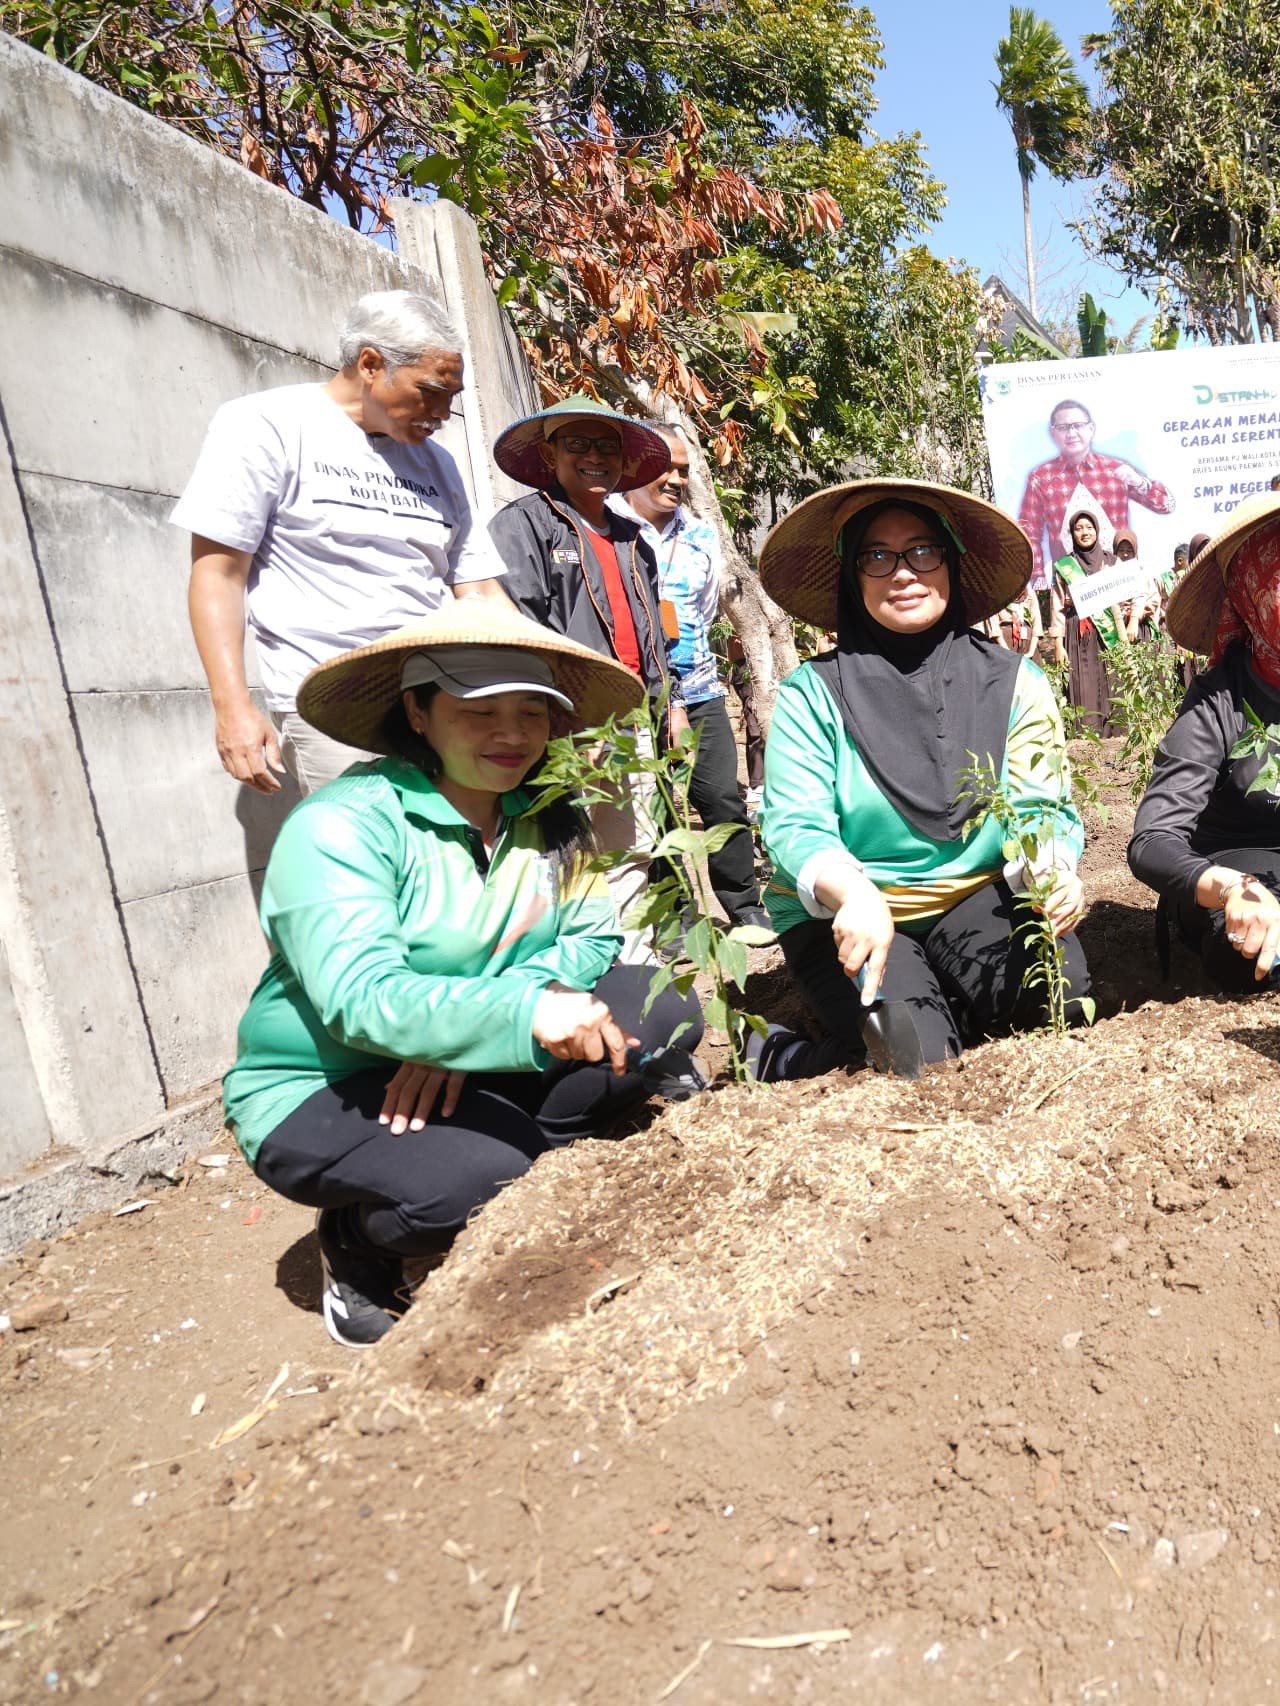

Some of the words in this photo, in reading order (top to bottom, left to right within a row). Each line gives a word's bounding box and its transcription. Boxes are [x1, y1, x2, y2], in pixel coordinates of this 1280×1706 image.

[1017, 376, 1046, 384] DINAS
[1048, 371, 1102, 381] PERTANIAN
[1163, 416, 1233, 433] GERAKAN
[1181, 433, 1226, 448] CABAI
[1197, 454, 1230, 465] BERSAMA
[314, 461, 360, 481] DINAS
[365, 471, 440, 497] PENDIDIKA
[350, 485, 388, 503] KOTA
[1193, 485, 1224, 498] SMP
[1230, 480, 1272, 495] NEGER
[1213, 499, 1241, 513] KOT
